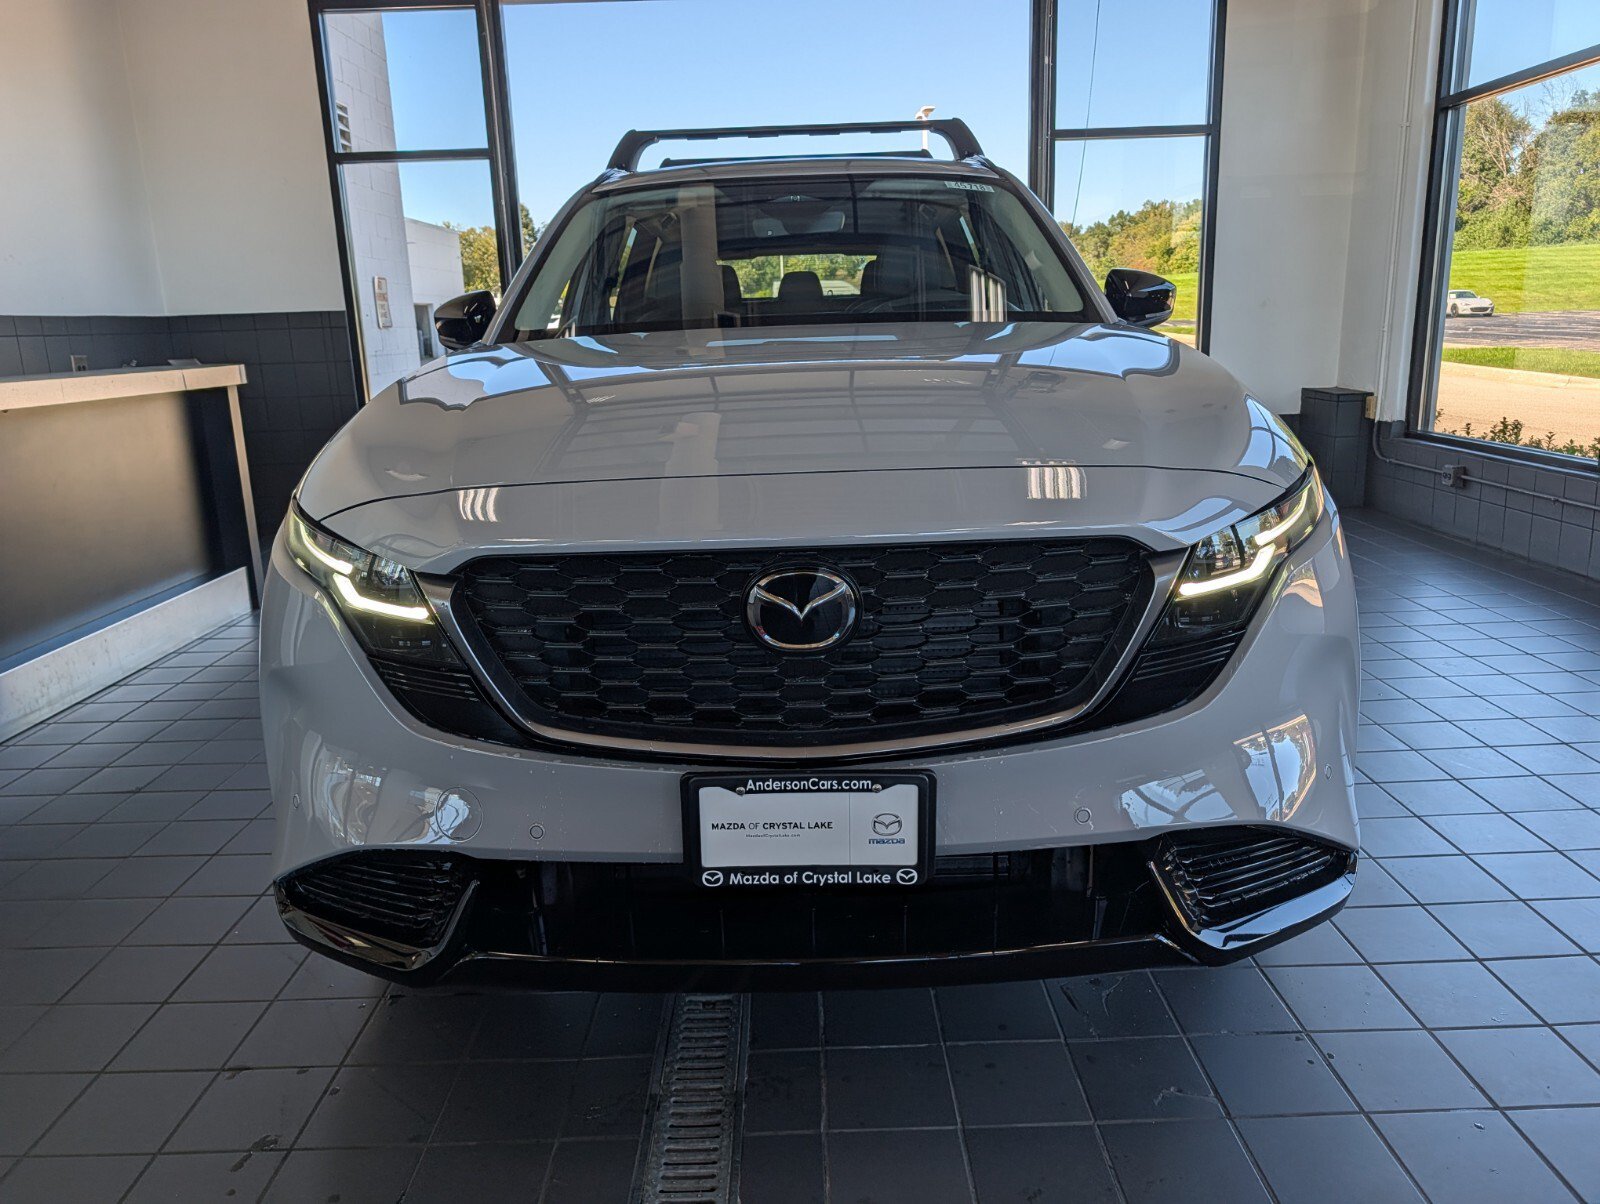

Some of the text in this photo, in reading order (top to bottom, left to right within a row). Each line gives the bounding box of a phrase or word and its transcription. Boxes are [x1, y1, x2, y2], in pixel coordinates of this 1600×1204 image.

[746, 778, 872, 791] AndersonCars.com
[711, 821, 833, 831] MAZDA OF CRYSTAL LAKE
[729, 870, 891, 887] Mazda of Crystal Lake
